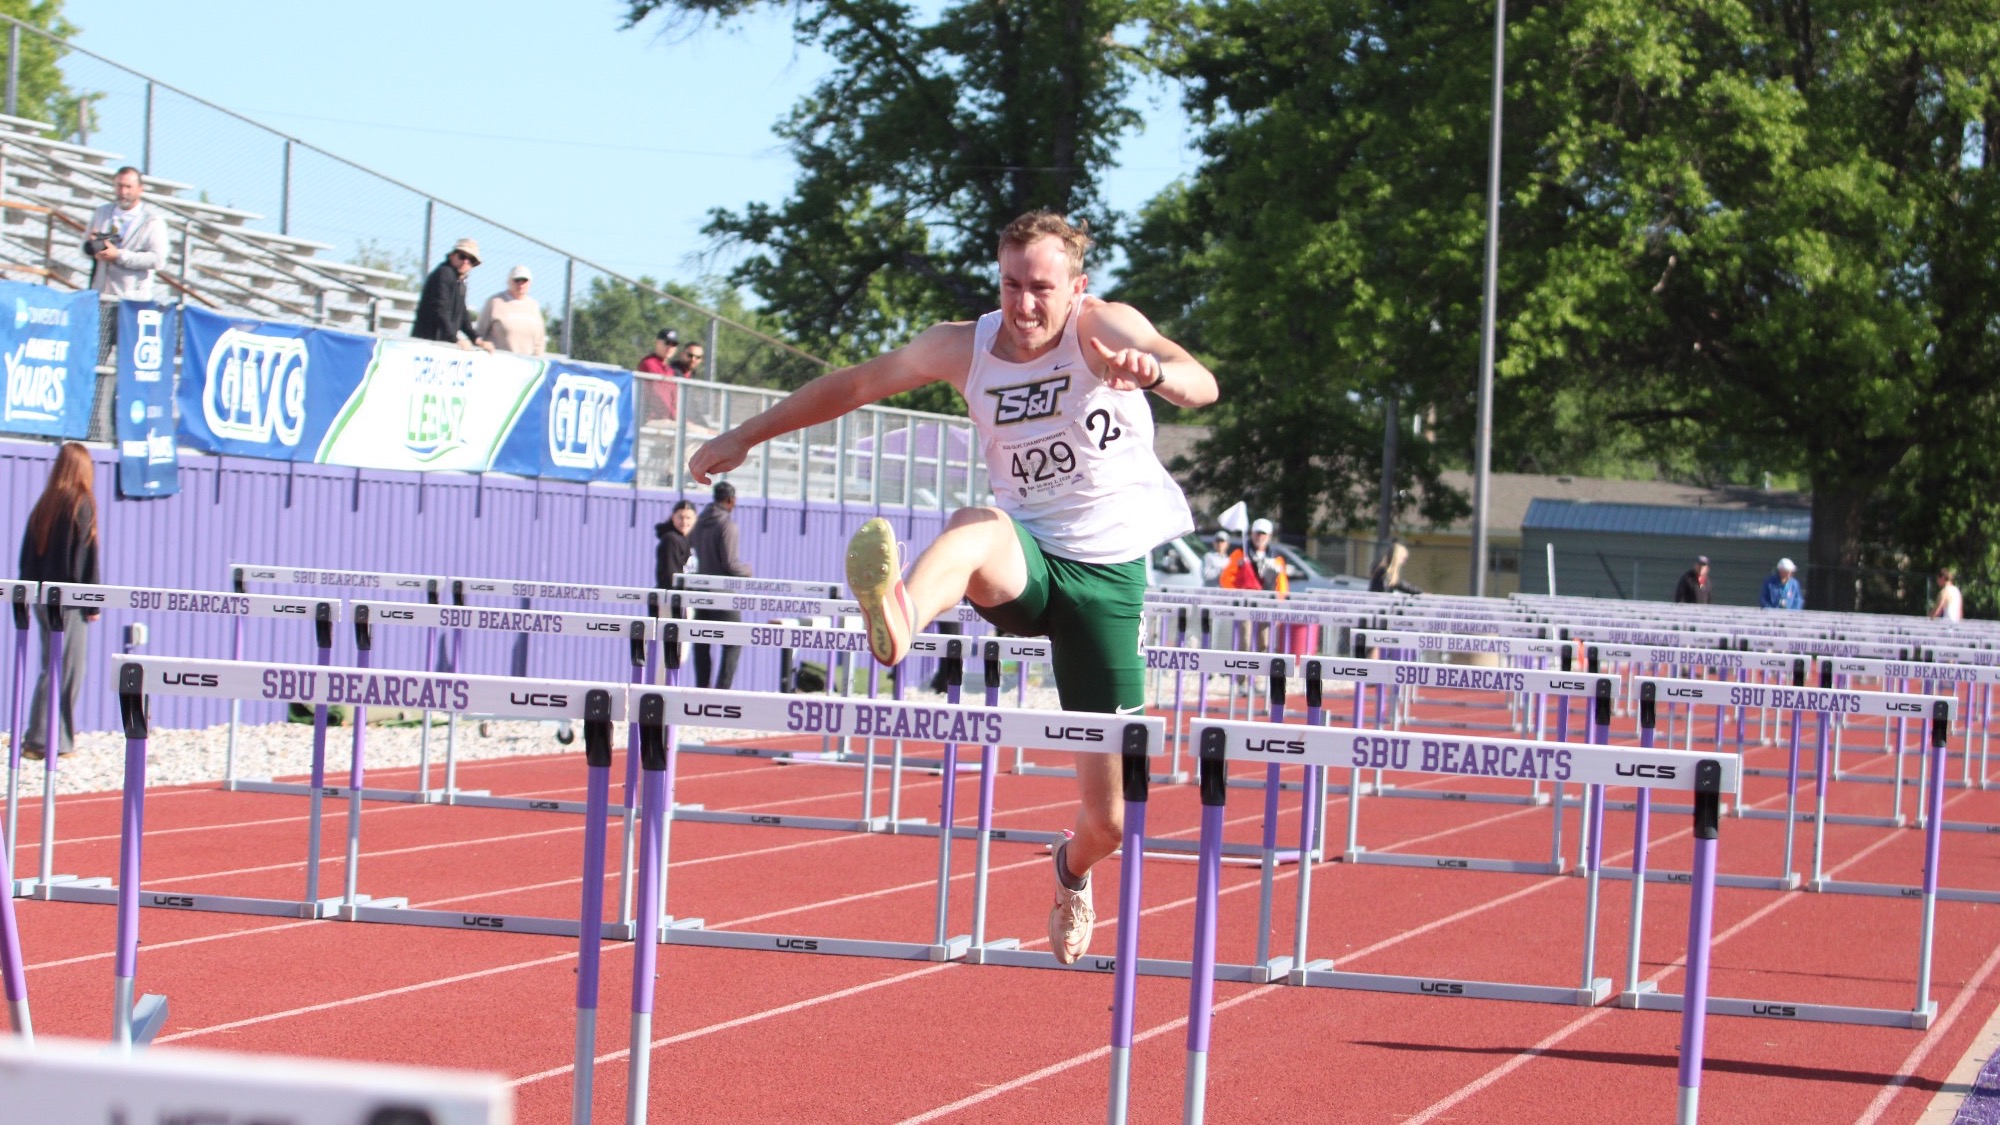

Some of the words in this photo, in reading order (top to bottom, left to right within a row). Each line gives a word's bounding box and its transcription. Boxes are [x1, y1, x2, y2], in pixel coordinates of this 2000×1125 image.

[4, 343, 67, 422] YOURS
[990, 376, 1070, 424] S&T
[1086, 409, 1121, 450] 2
[1023, 431, 1066, 447] CHAMPIONSHIPS
[1011, 441, 1076, 484] 429
[251, 571, 275, 579] UCS
[293, 571, 316, 585] SBU
[320, 573, 380, 588] BEARCATS
[512, 583, 536, 598] SBU
[539, 585, 600, 601] BEARCATS
[723, 578, 741, 590] SBU
[745, 580, 792, 593] BEARCATS
[72, 592, 105, 602] UCS
[130, 590, 160, 609] SBU
[167, 593, 250, 615] BEARCATS
[616, 592, 640, 600] UCS
[273, 604, 306, 614] UCS
[731, 597, 755, 611] SBU
[760, 599, 821, 615] BEARCATS
[380, 610, 414, 620] UCS
[439, 609, 473, 628] SBU
[478, 611, 562, 633] BEARCATS
[1250, 611, 1267, 622] SBU
[1271, 612, 1320, 624] BEARCATS
[586, 622, 620, 632] UCS
[690, 628, 724, 638] UCS
[1428, 620, 1447, 631] SBU
[1450, 622, 1499, 634] BEARCATS
[751, 627, 784, 646] SBU
[790, 629, 872, 652] BEARCAT
[1608, 630, 1628, 641] SBU
[1631, 631, 1680, 644] BEARCATS
[911, 641, 936, 651] CS
[1010, 646, 1045, 657] UCS
[1418, 636, 1443, 650] SBU
[1447, 638, 1511, 653] BEARCATS
[1788, 641, 1808, 652] SBU
[1811, 642, 1860, 655] BEARCATS
[1146, 650, 1200, 671] RCATS
[1651, 650, 1675, 664] SBU
[1679, 652, 1743, 668] BEARCATS
[1974, 651, 1993, 664] SBU
[1224, 660, 1259, 670] UCS
[1333, 667, 1368, 676] UCS
[163, 672, 219, 687] UCS
[1395, 666, 1429, 687] SBU
[1436, 668, 1524, 691] BEARCATS
[1885, 663, 1910, 677] SBU
[1914, 665, 1977, 682] BEARCATS
[262, 669, 317, 700] SBU
[327, 672, 470, 710] BEARCATS
[1550, 680, 1585, 690] UCS
[511, 692, 568, 707] UCS
[1668, 688, 1703, 698] UCS
[1730, 688, 1764, 708] SBU
[1771, 690, 1860, 713] BEARCATS
[1886, 702, 1921, 712] UCS
[684, 703, 742, 719] UCS
[787, 701, 844, 732] SBU
[854, 704, 1002, 743] BEARCATS
[1045, 725, 1104, 741] UCS
[1246, 738, 1305, 755] UCS
[1352, 736, 1410, 769] SBU
[1421, 740, 1572, 781] BEARCATS
[1616, 762, 1676, 779] UCS
[322, 788, 338, 796] CS
[529, 801, 559, 810] UCS
[751, 815, 781, 824] UCS
[1437, 859, 1468, 868] UCS
[1668, 874, 1692, 882] UC
[1901, 887, 1922, 896] UC
[154, 896, 193, 907] UCS
[463, 916, 504, 928] UCS
[775, 938, 818, 950] UCS
[1421, 982, 1463, 995] UCS
[1753, 1004, 1796, 1017] UCS
